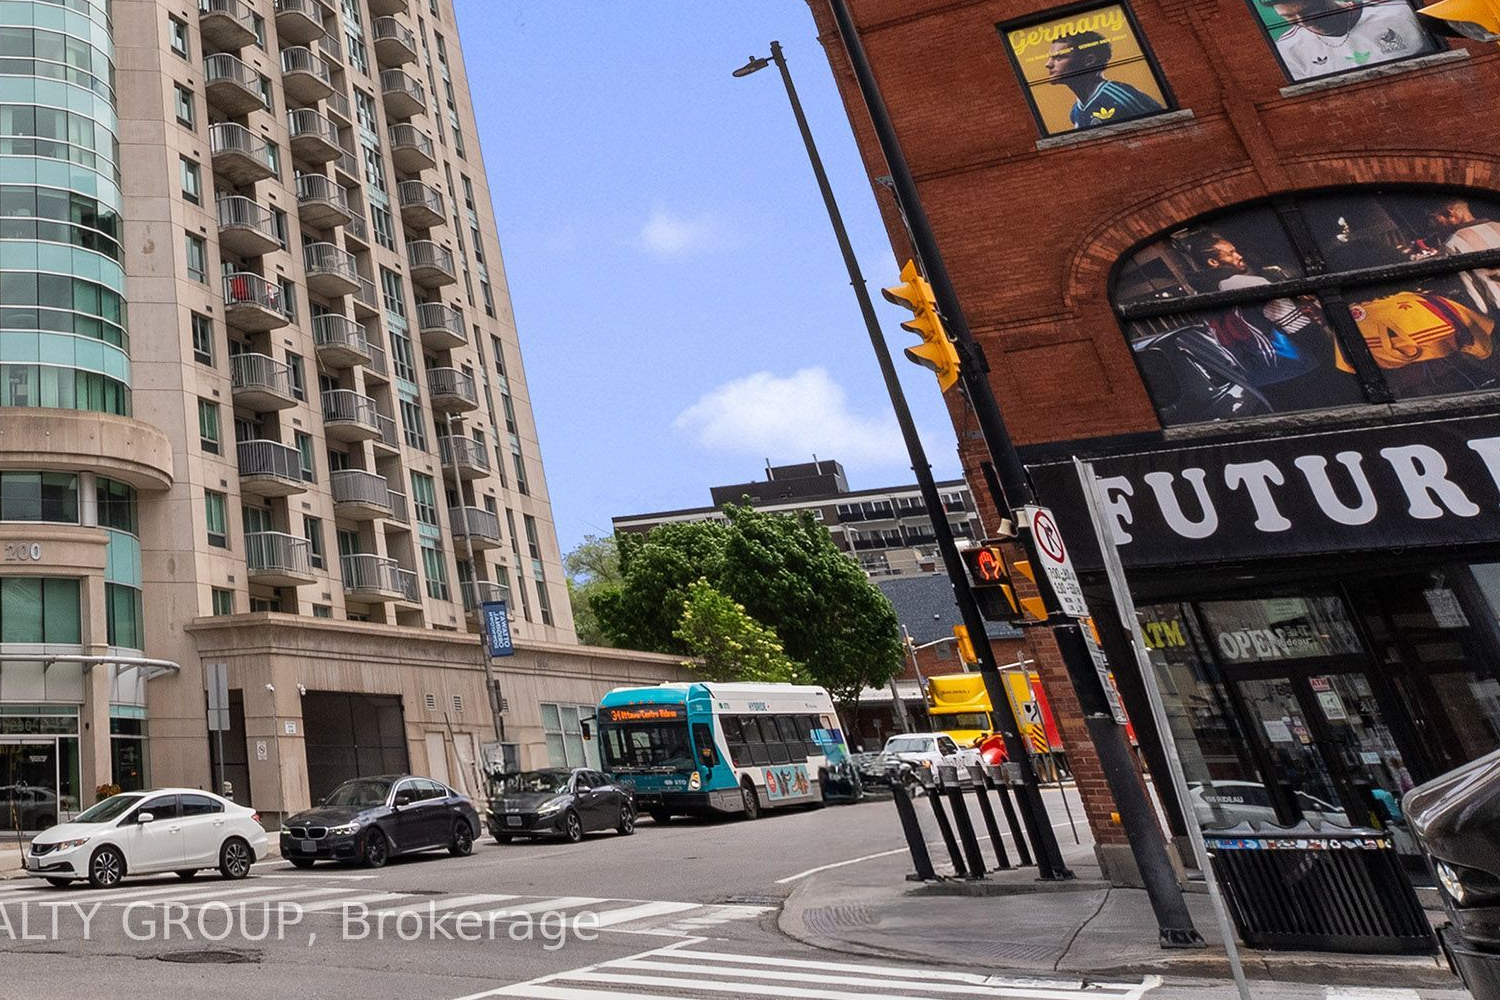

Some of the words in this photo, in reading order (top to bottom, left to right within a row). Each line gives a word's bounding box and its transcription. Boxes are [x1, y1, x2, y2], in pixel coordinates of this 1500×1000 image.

[1008, 9, 1127, 56] Germany
[3, 542, 42, 561] 200
[1218, 629, 1291, 660] OPEN
